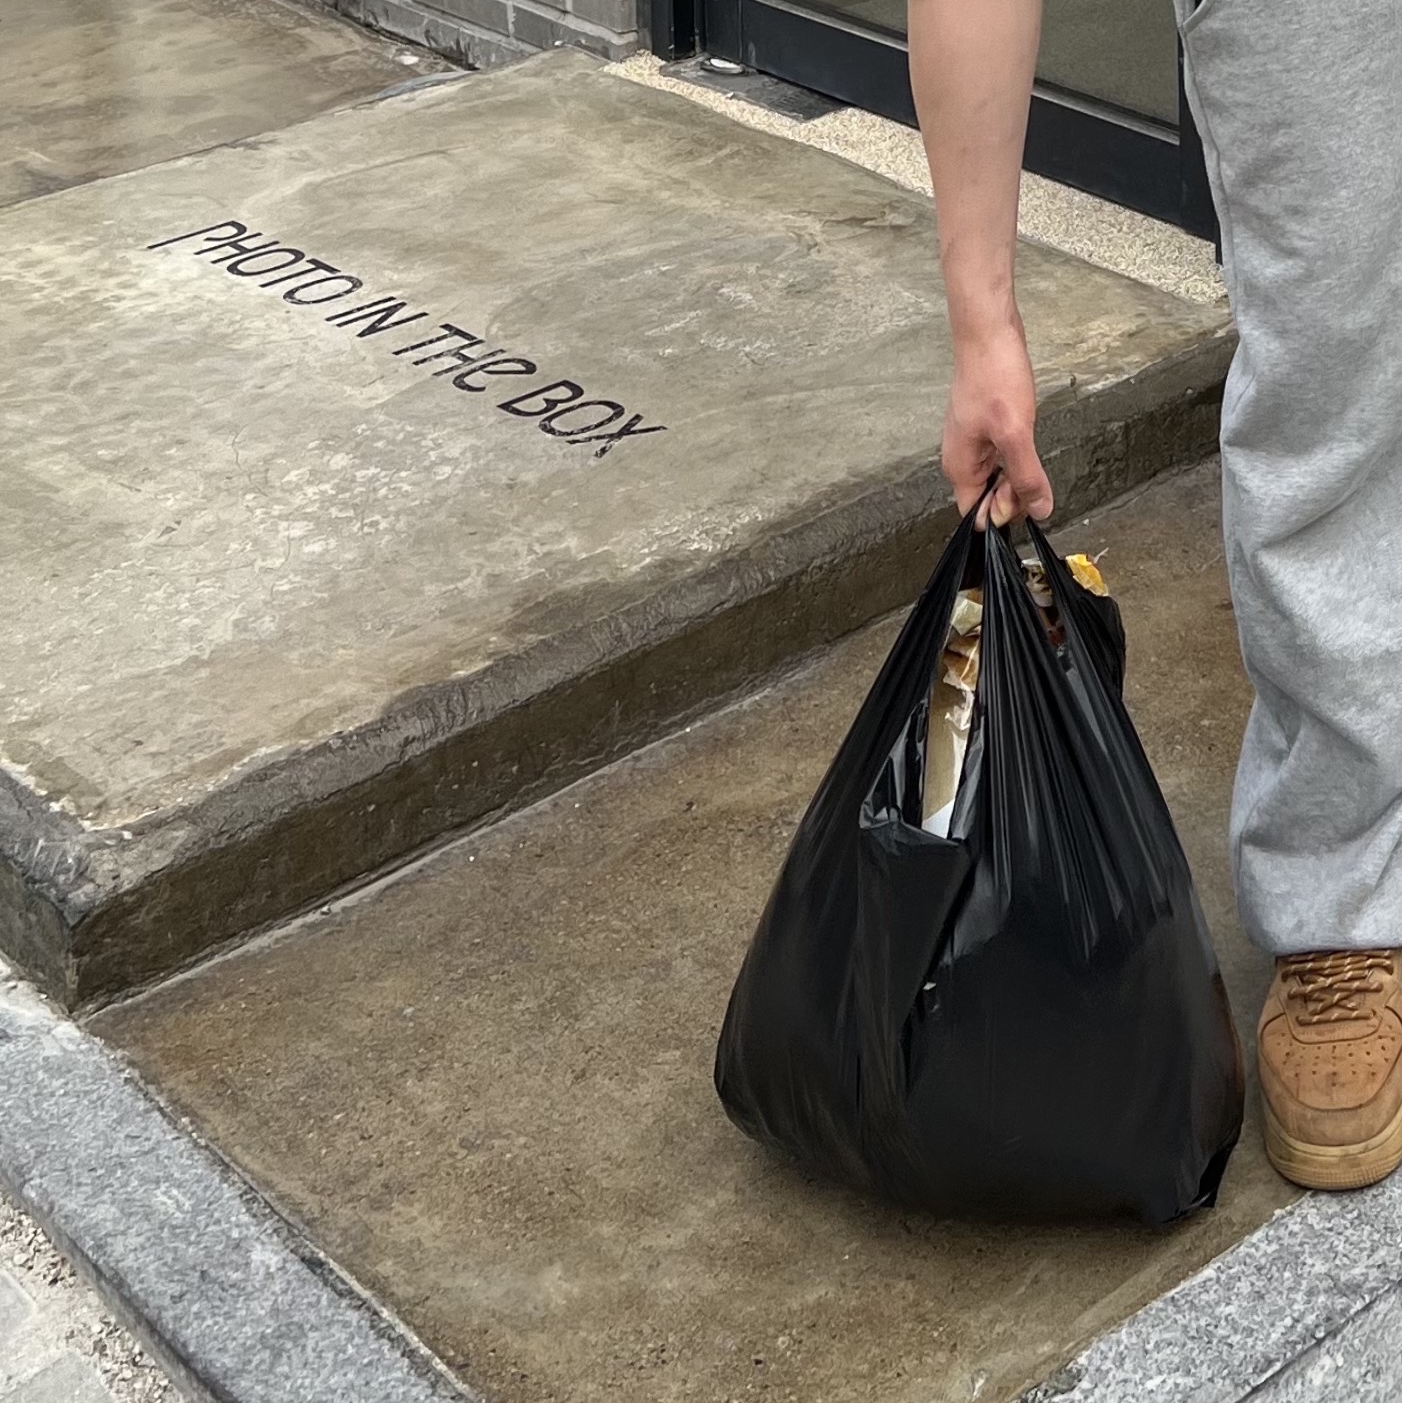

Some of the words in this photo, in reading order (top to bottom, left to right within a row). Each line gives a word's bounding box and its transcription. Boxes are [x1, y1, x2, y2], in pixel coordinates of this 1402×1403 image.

[147, 220, 363, 305] PHOTO
[324, 296, 429, 337] IN
[497, 379, 668, 458] BOX
